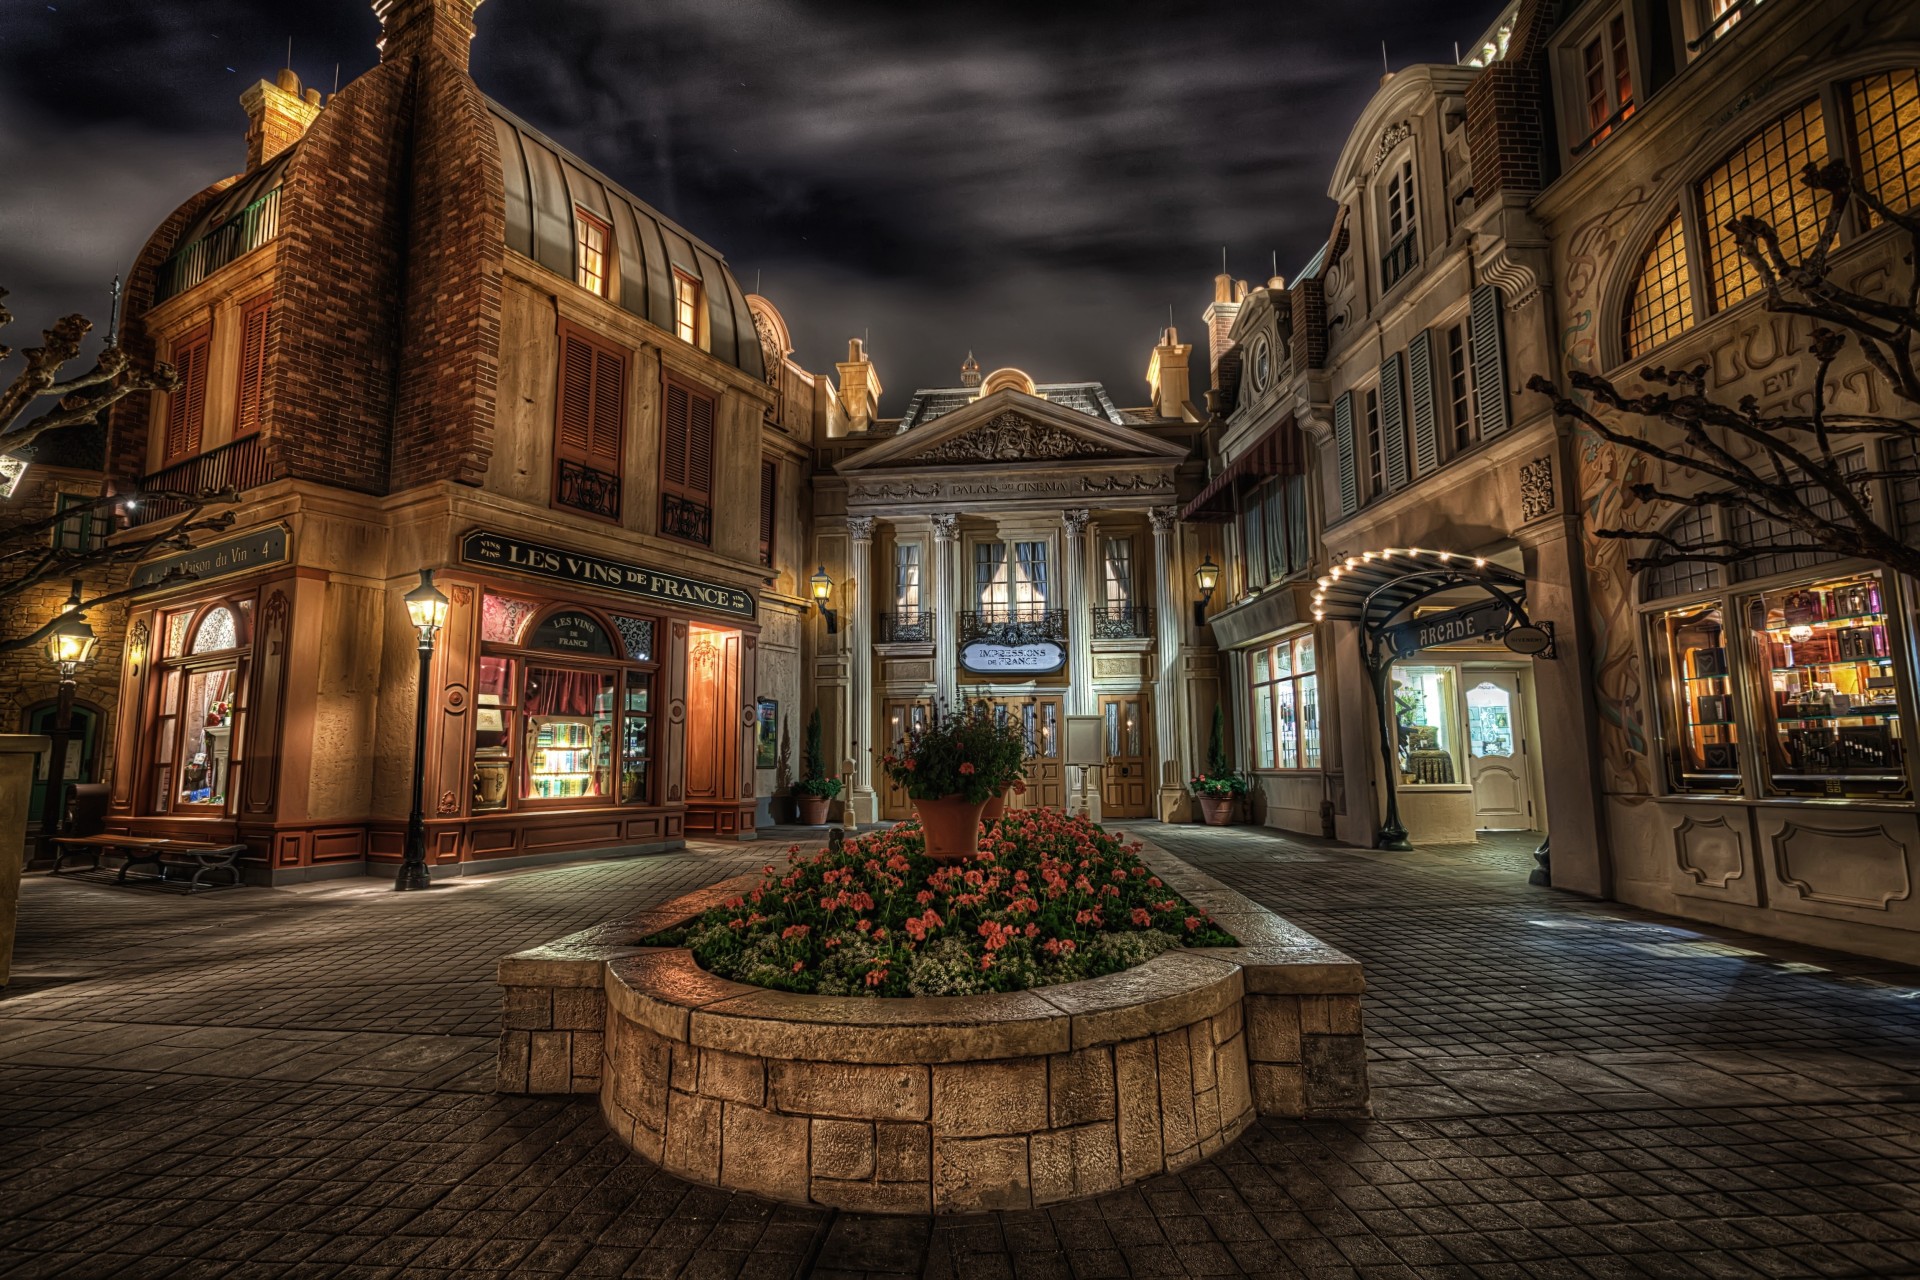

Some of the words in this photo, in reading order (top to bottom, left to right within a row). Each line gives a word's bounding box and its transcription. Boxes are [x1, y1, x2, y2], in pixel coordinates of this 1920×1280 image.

[1763, 367, 1797, 397] ET
[952, 484, 999, 495] PALAIS
[1017, 481, 1067, 493] CINEMA
[480, 540, 501, 550] VINS
[180, 560, 211, 576] Maison
[215, 552, 227, 568] du
[231, 546, 247, 563] Vin
[261, 540, 269, 558] 4
[480, 549, 501, 559] FINS
[508, 545, 560, 572] LES
[565, 557, 622, 585] VINS
[626, 570, 647, 585] DE
[650, 576, 729, 607] FRANCE
[554, 617, 572, 629] LES
[574, 617, 595, 633] VINS
[1420, 616, 1476, 646] ARCADE
[559, 637, 589, 648] FRANCE
[979, 649, 1046, 658] IMPRESSIONS
[998, 657, 1038, 666] FRANCE
